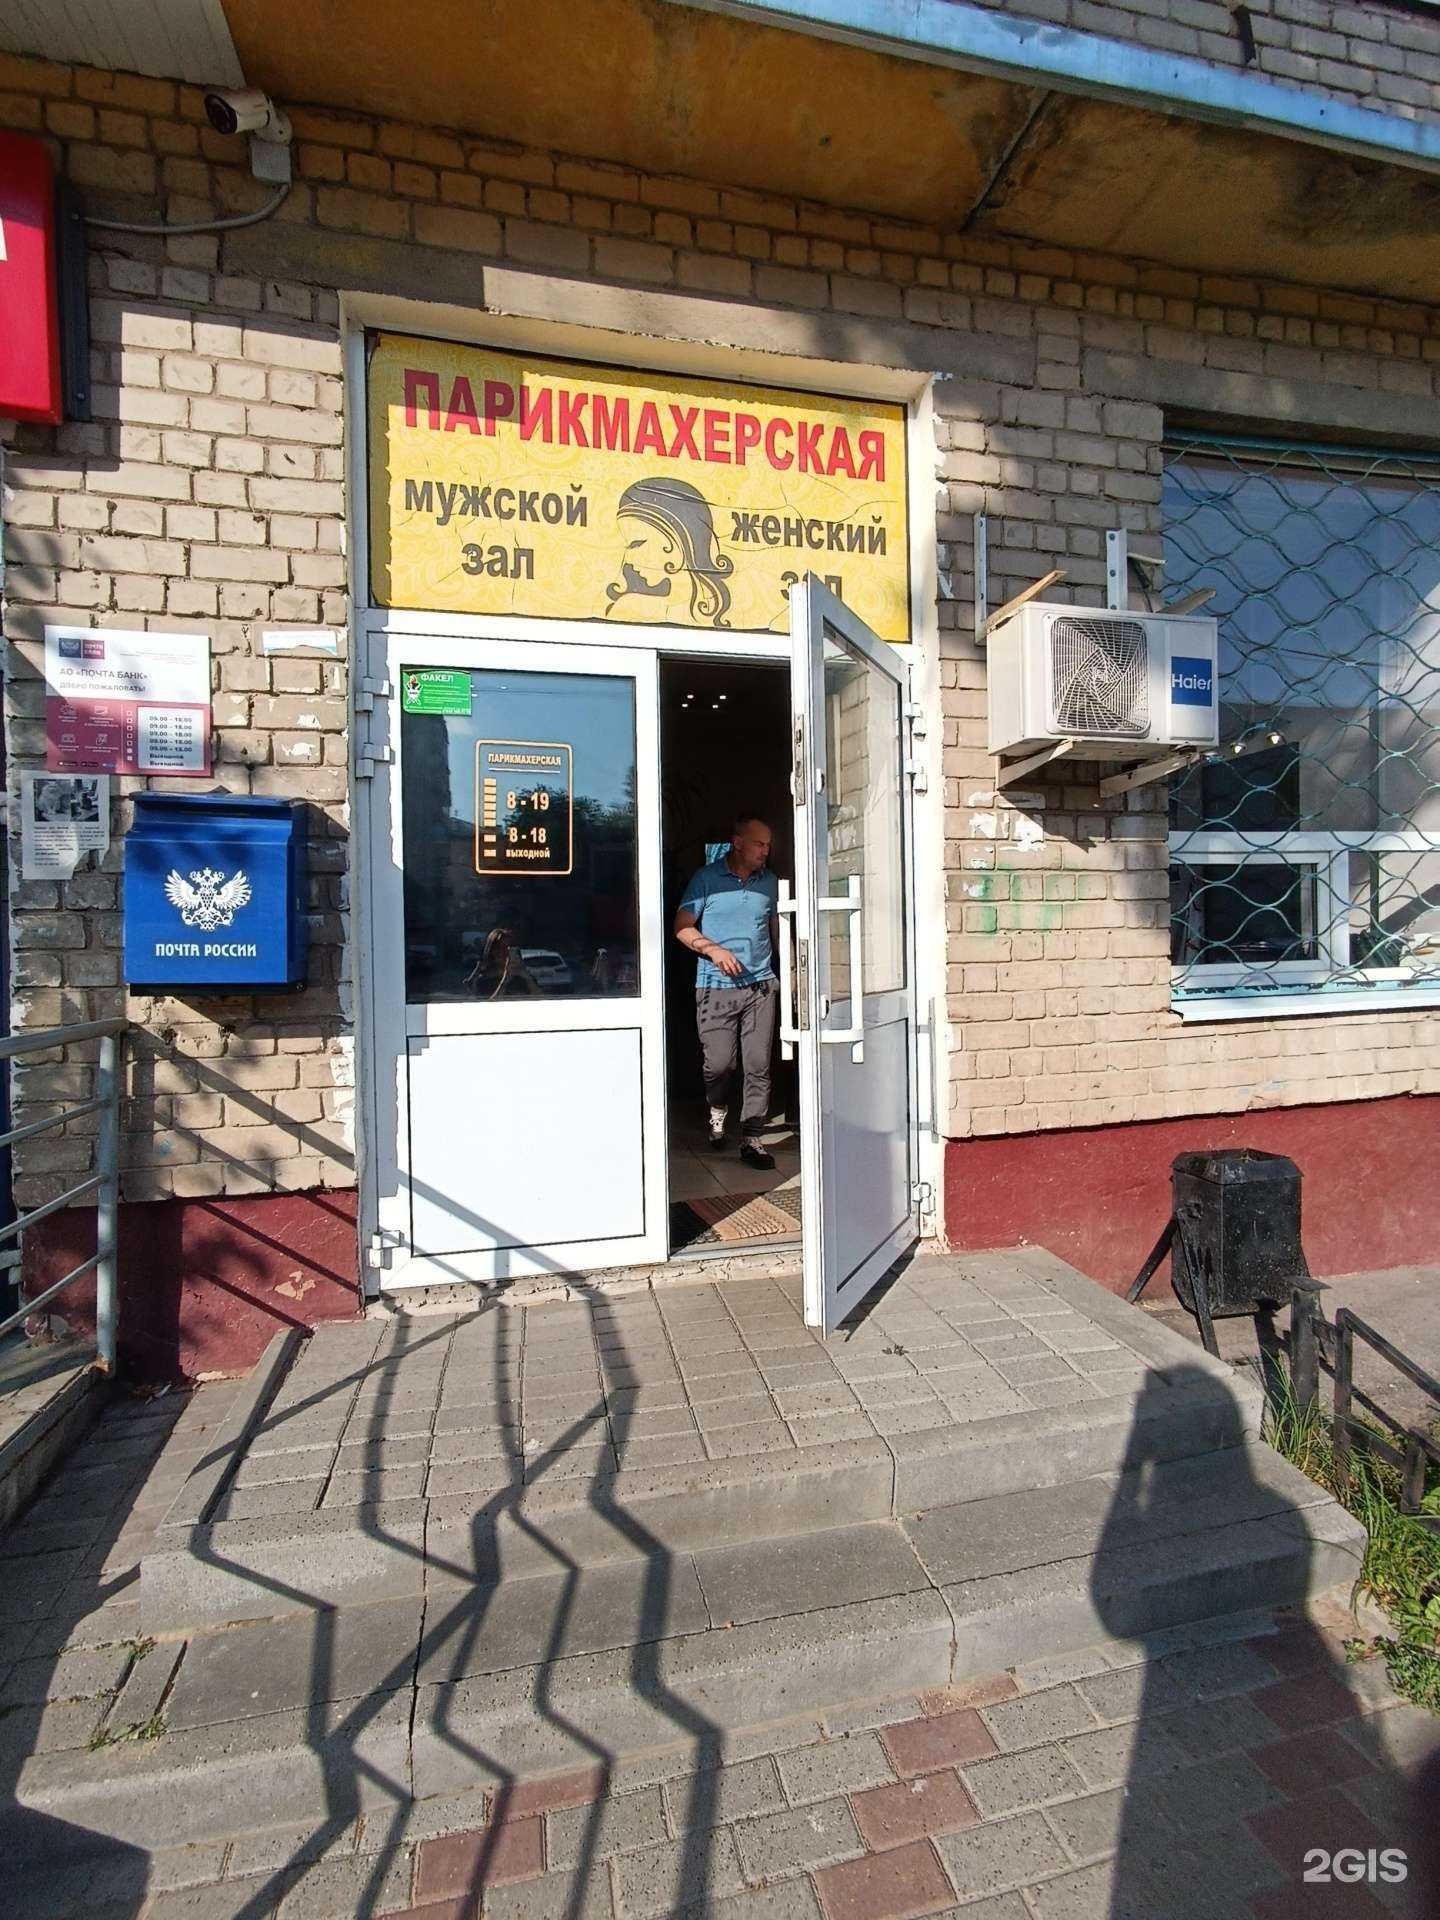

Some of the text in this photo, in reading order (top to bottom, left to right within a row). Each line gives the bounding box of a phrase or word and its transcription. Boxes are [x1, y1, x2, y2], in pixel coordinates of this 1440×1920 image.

[403, 367, 886, 483] ПАРИКМАХЕРСКАЯ
[404, 478, 588, 528] мужской
[731, 510, 887, 556] женский
[461, 542, 535, 580] зал
[780, 570, 842, 601] зл
[421, 673, 454, 683] ФАКЕЛ
[1172, 673, 1212, 691] Haier
[488, 753, 562, 766] ПАРИКМАХЕРСКАЯ
[506, 791, 517, 809] 8
[530, 792, 549, 810] 19
[509, 827, 518, 843] 8
[530, 827, 547, 843] 18
[155, 943, 257, 957] ПОЧТА РОССИИ
